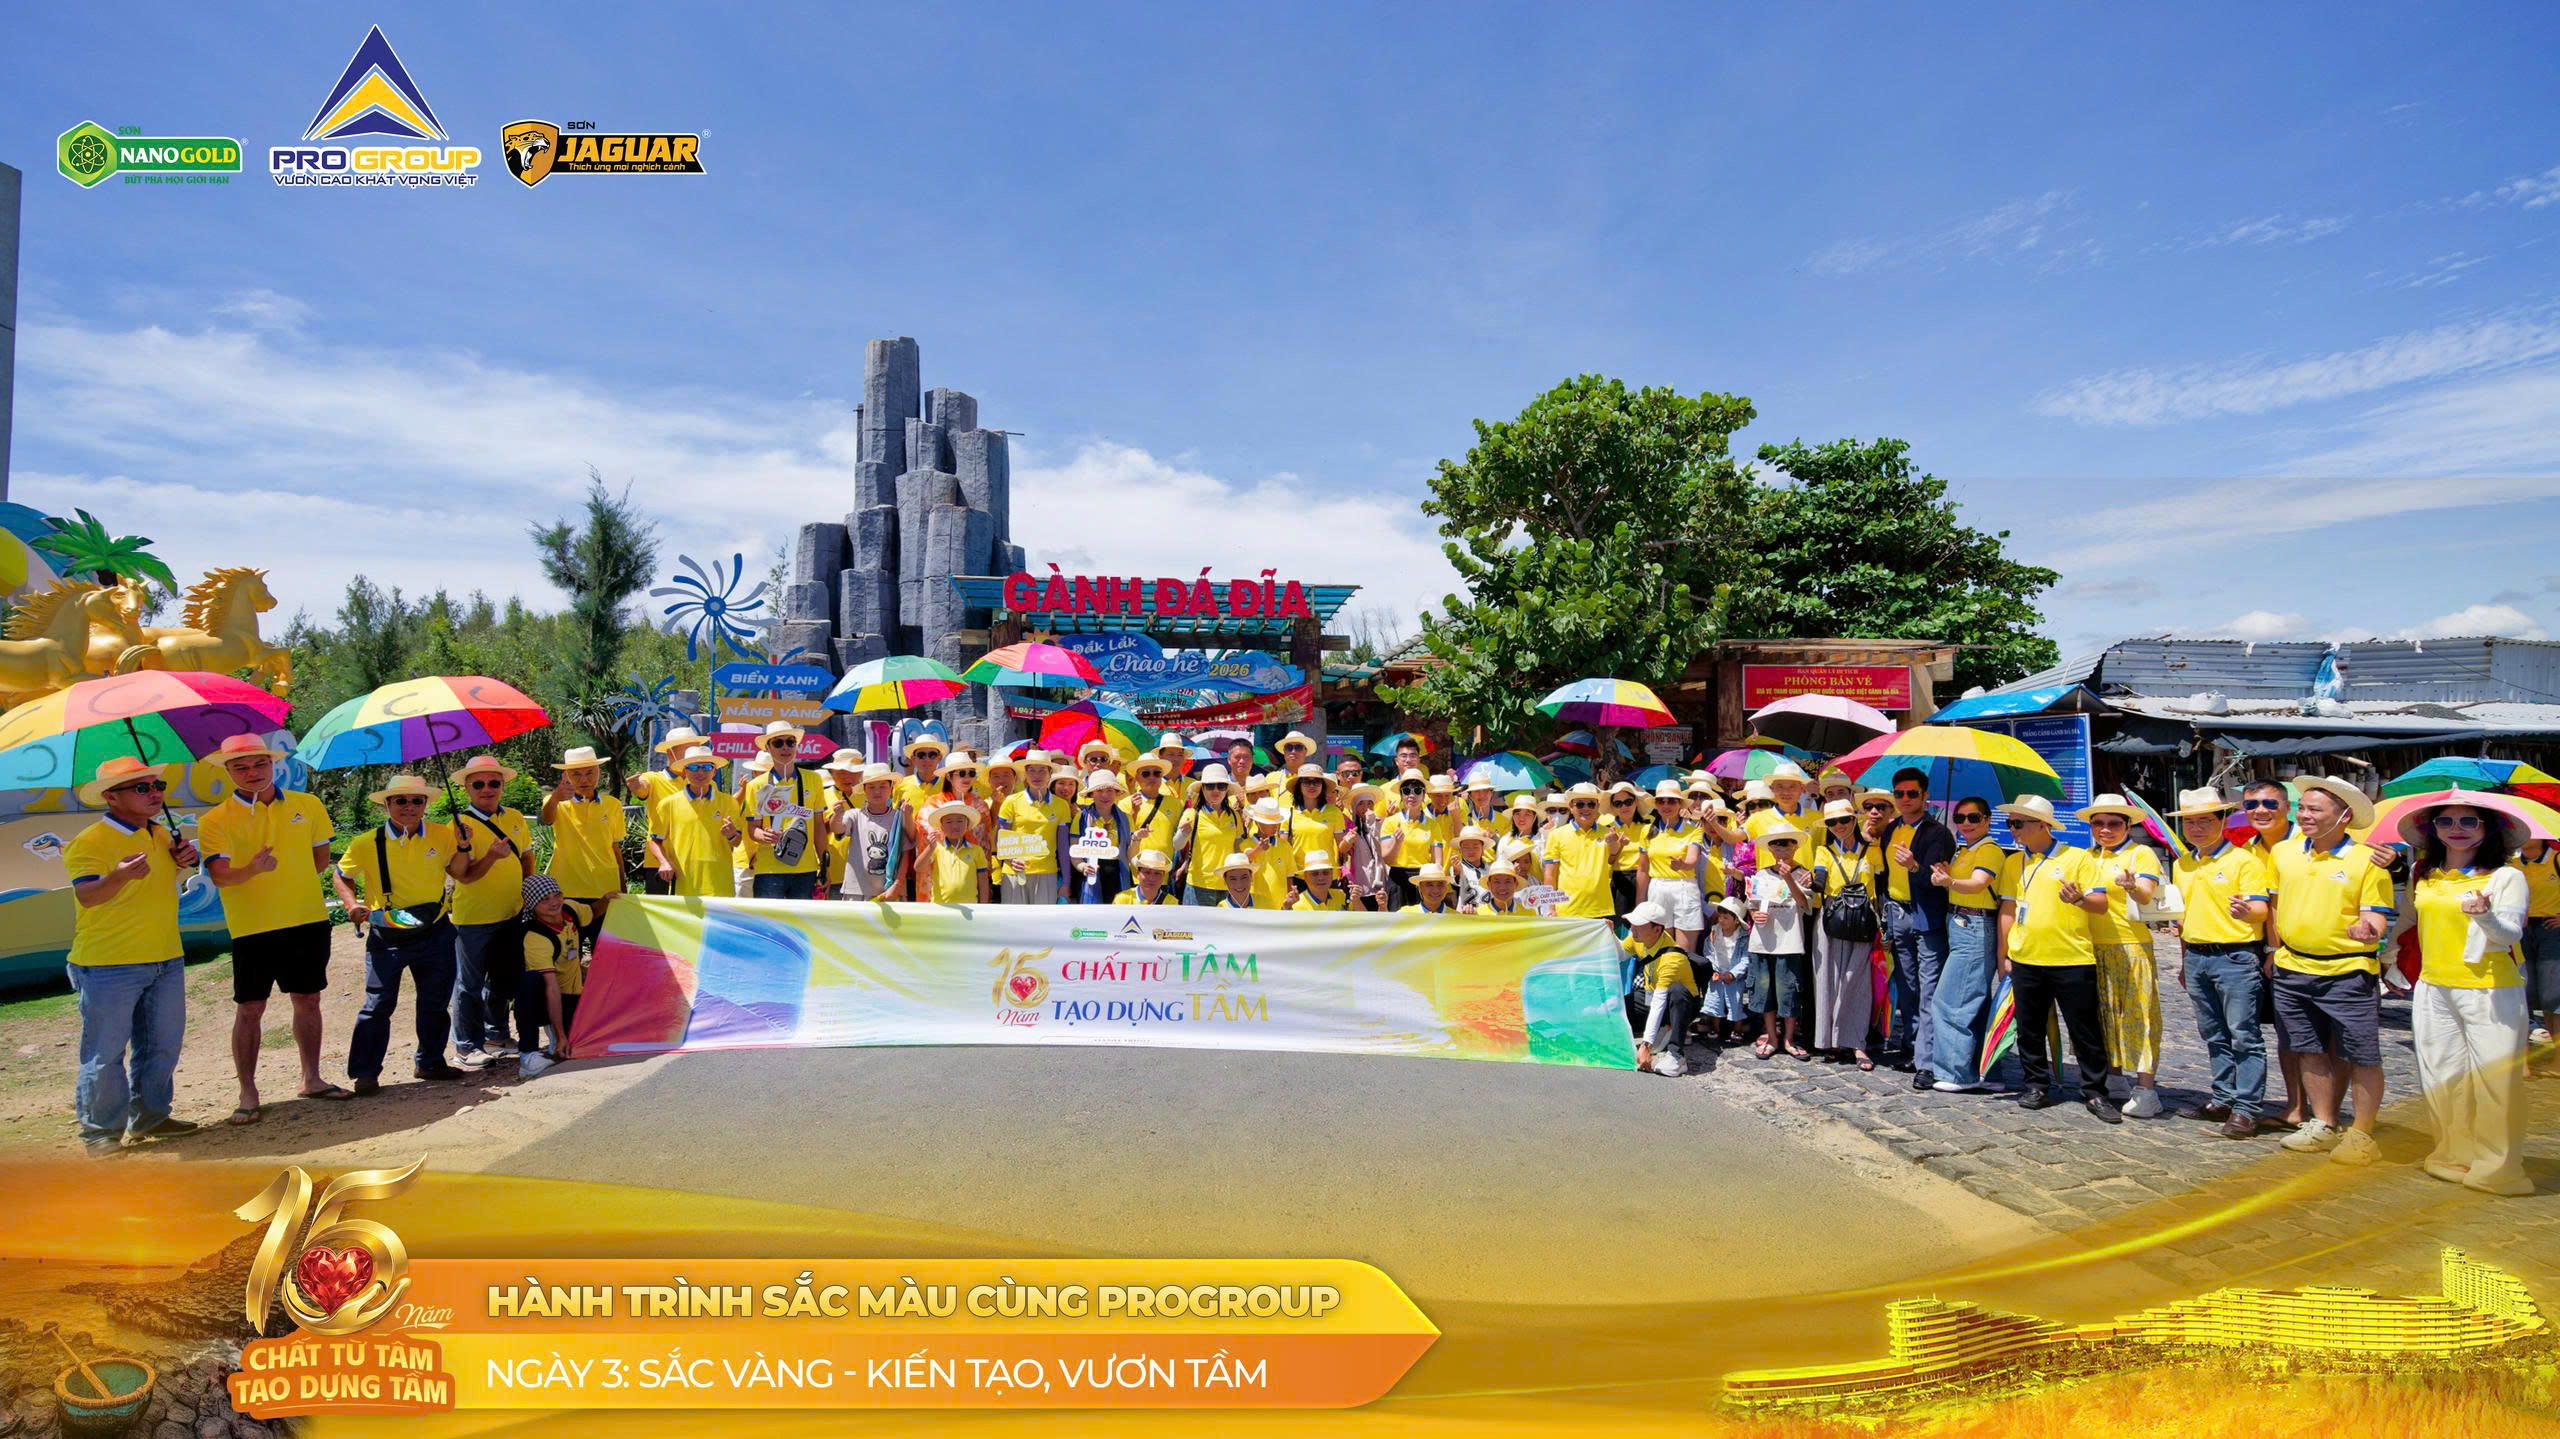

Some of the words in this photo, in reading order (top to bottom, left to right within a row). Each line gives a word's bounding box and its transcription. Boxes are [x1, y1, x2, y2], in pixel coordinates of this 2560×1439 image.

[1003, 562, 1142, 615] GÀNH
[1154, 566, 1219, 616] ĐÁ
[1228, 568, 1311, 618] ĐĨA
[1109, 653, 1166, 673] Chào
[1172, 654, 1200, 673] hè
[1208, 663, 1251, 677] 2026
[730, 670, 769, 684] BIỂN
[774, 675, 818, 685] XANH
[1783, 675, 1827, 686] PHÒNG
[1829, 674, 1854, 686] BÁN
[725, 702, 774, 717] NẮNG
[779, 705, 823, 719] VÀNG
[716, 742, 755, 754] CHILL
[1082, 840, 1108, 848] PRO
[1061, 951, 1132, 981] CHẤT
[1137, 955, 1171, 981] TỪ
[1175, 944, 1258, 982] TÂM
[1051, 1000, 1101, 1026] TẠO
[1107, 998, 1184, 1026] DỰNG
[1185, 978, 1269, 1021] TẦM
[996, 1008, 1040, 1027] Năm
